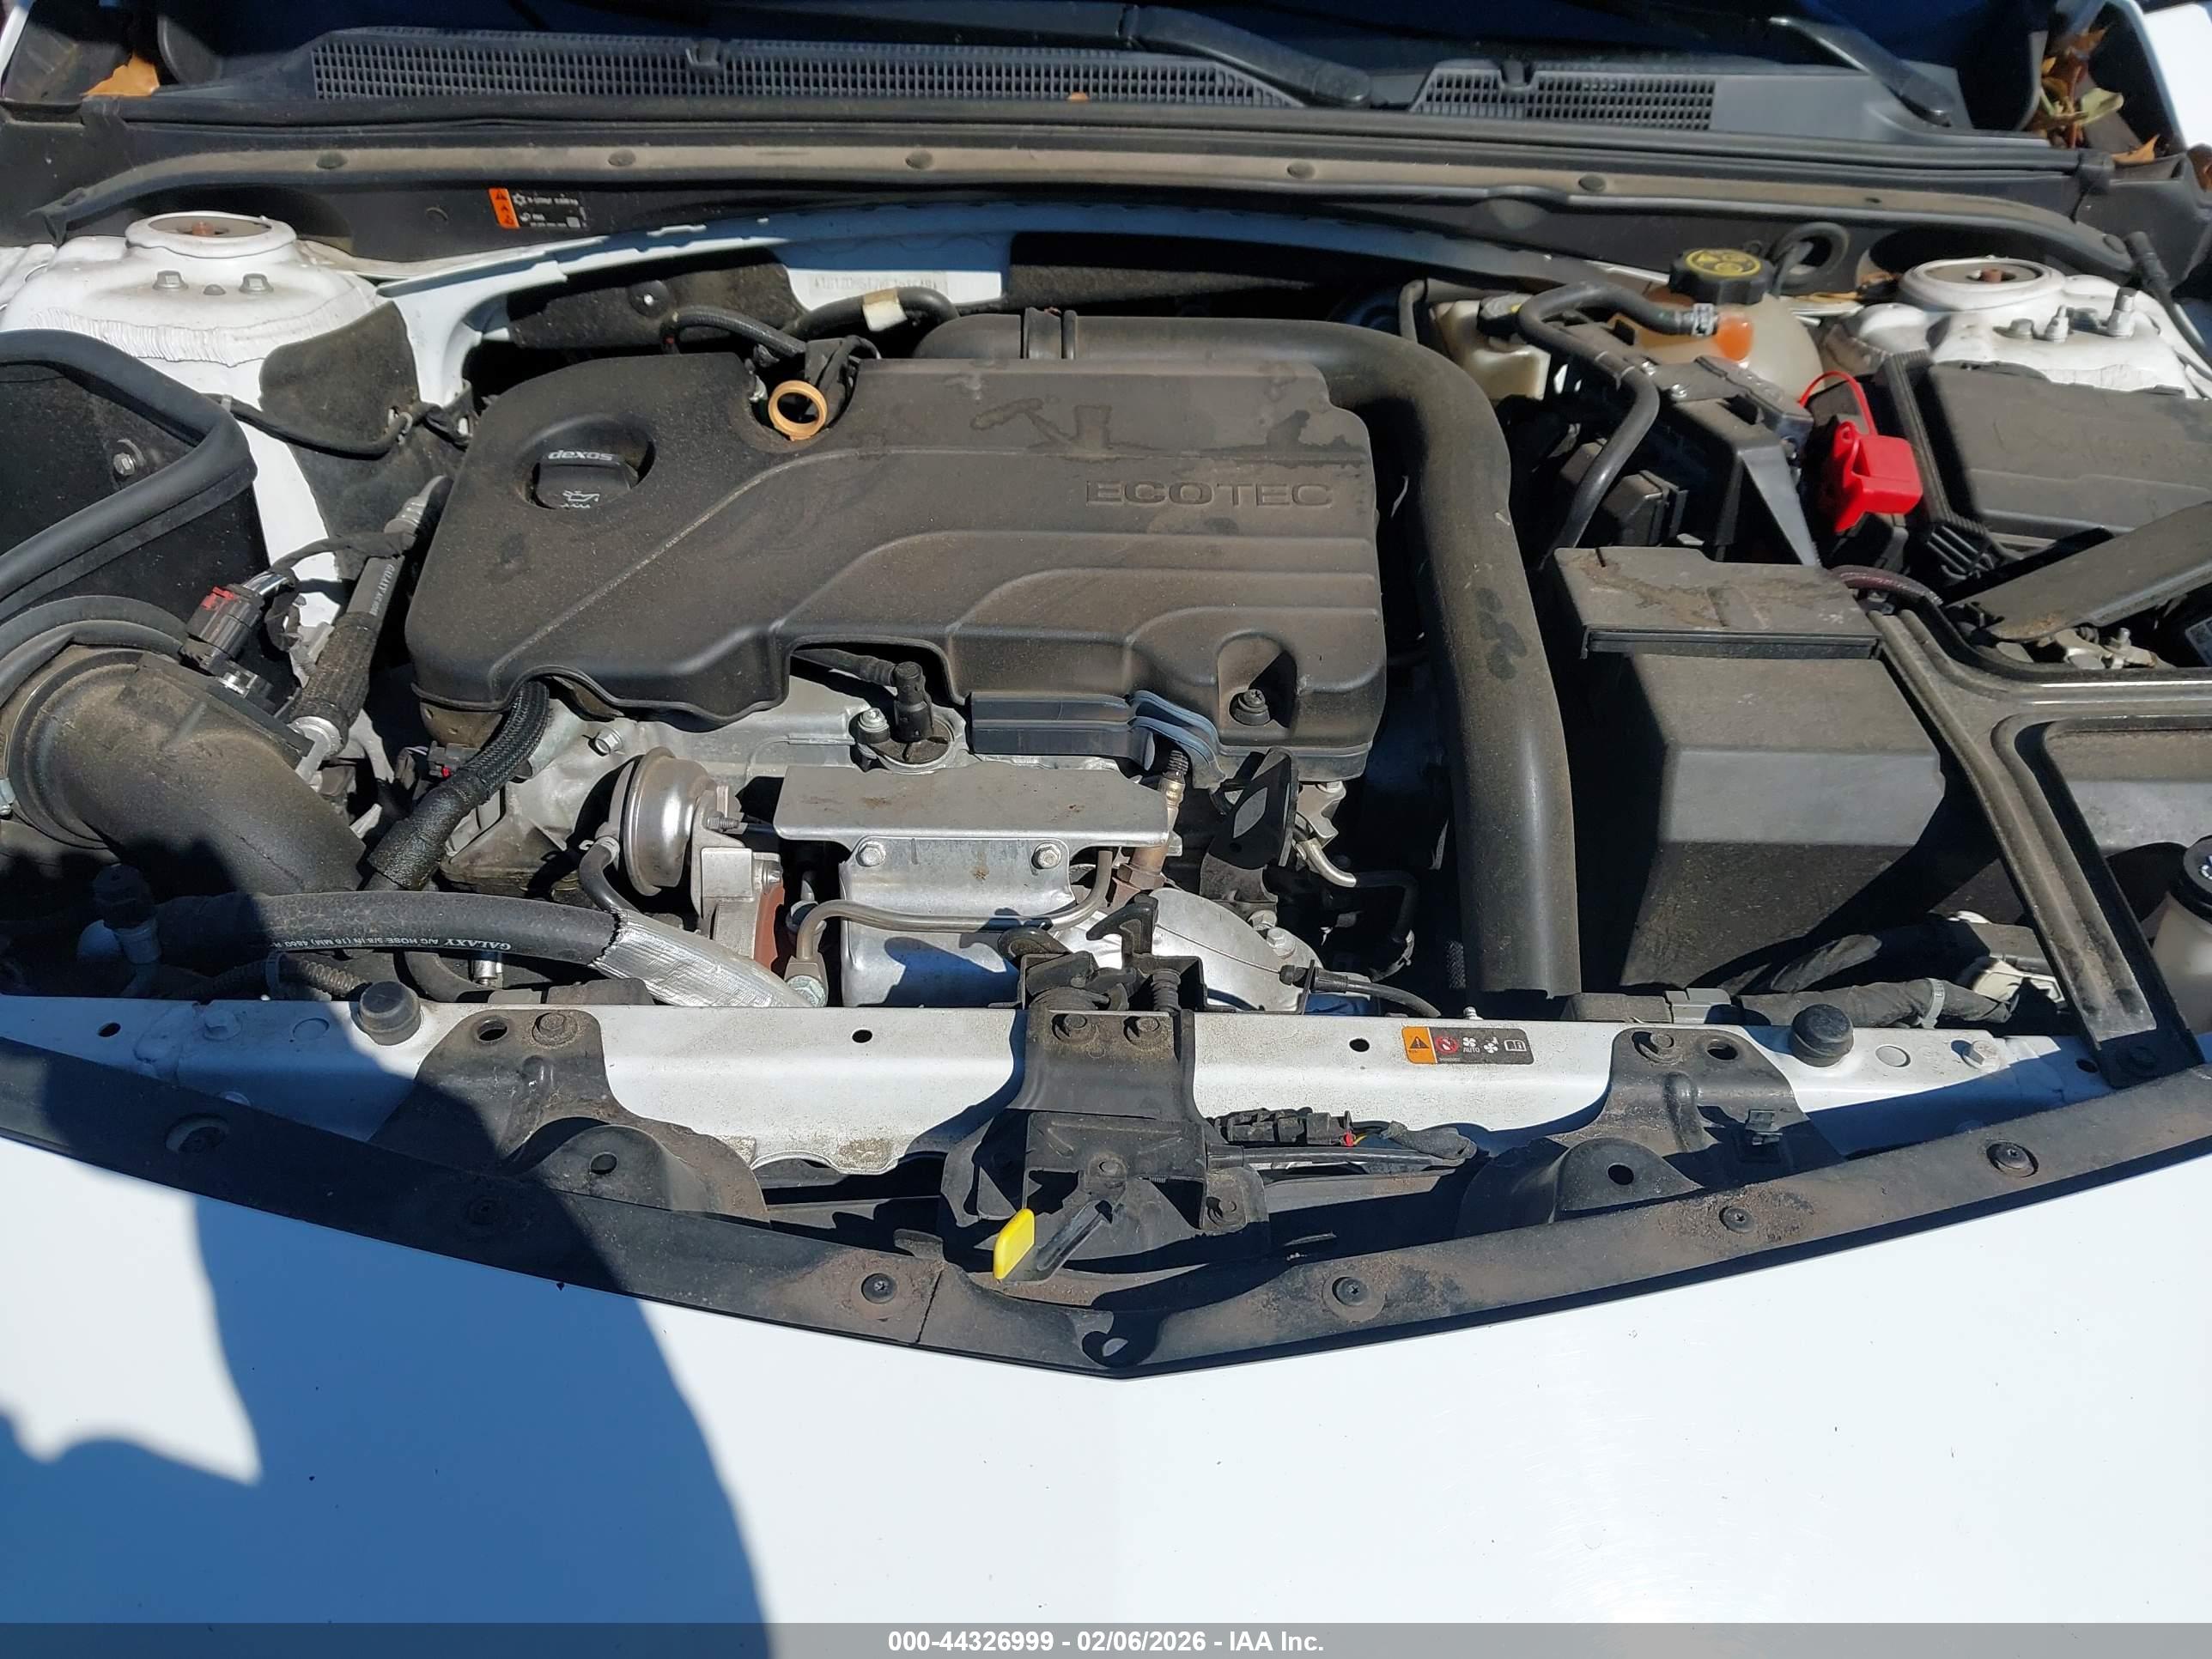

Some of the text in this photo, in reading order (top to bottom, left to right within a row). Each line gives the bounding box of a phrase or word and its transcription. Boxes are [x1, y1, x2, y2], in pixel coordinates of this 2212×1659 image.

[548, 450, 613, 461] dexos
[1086, 480, 1333, 507] ECOTEC
[420, 937, 439, 945] A/C
[443, 938, 512, 951] GALAXY
